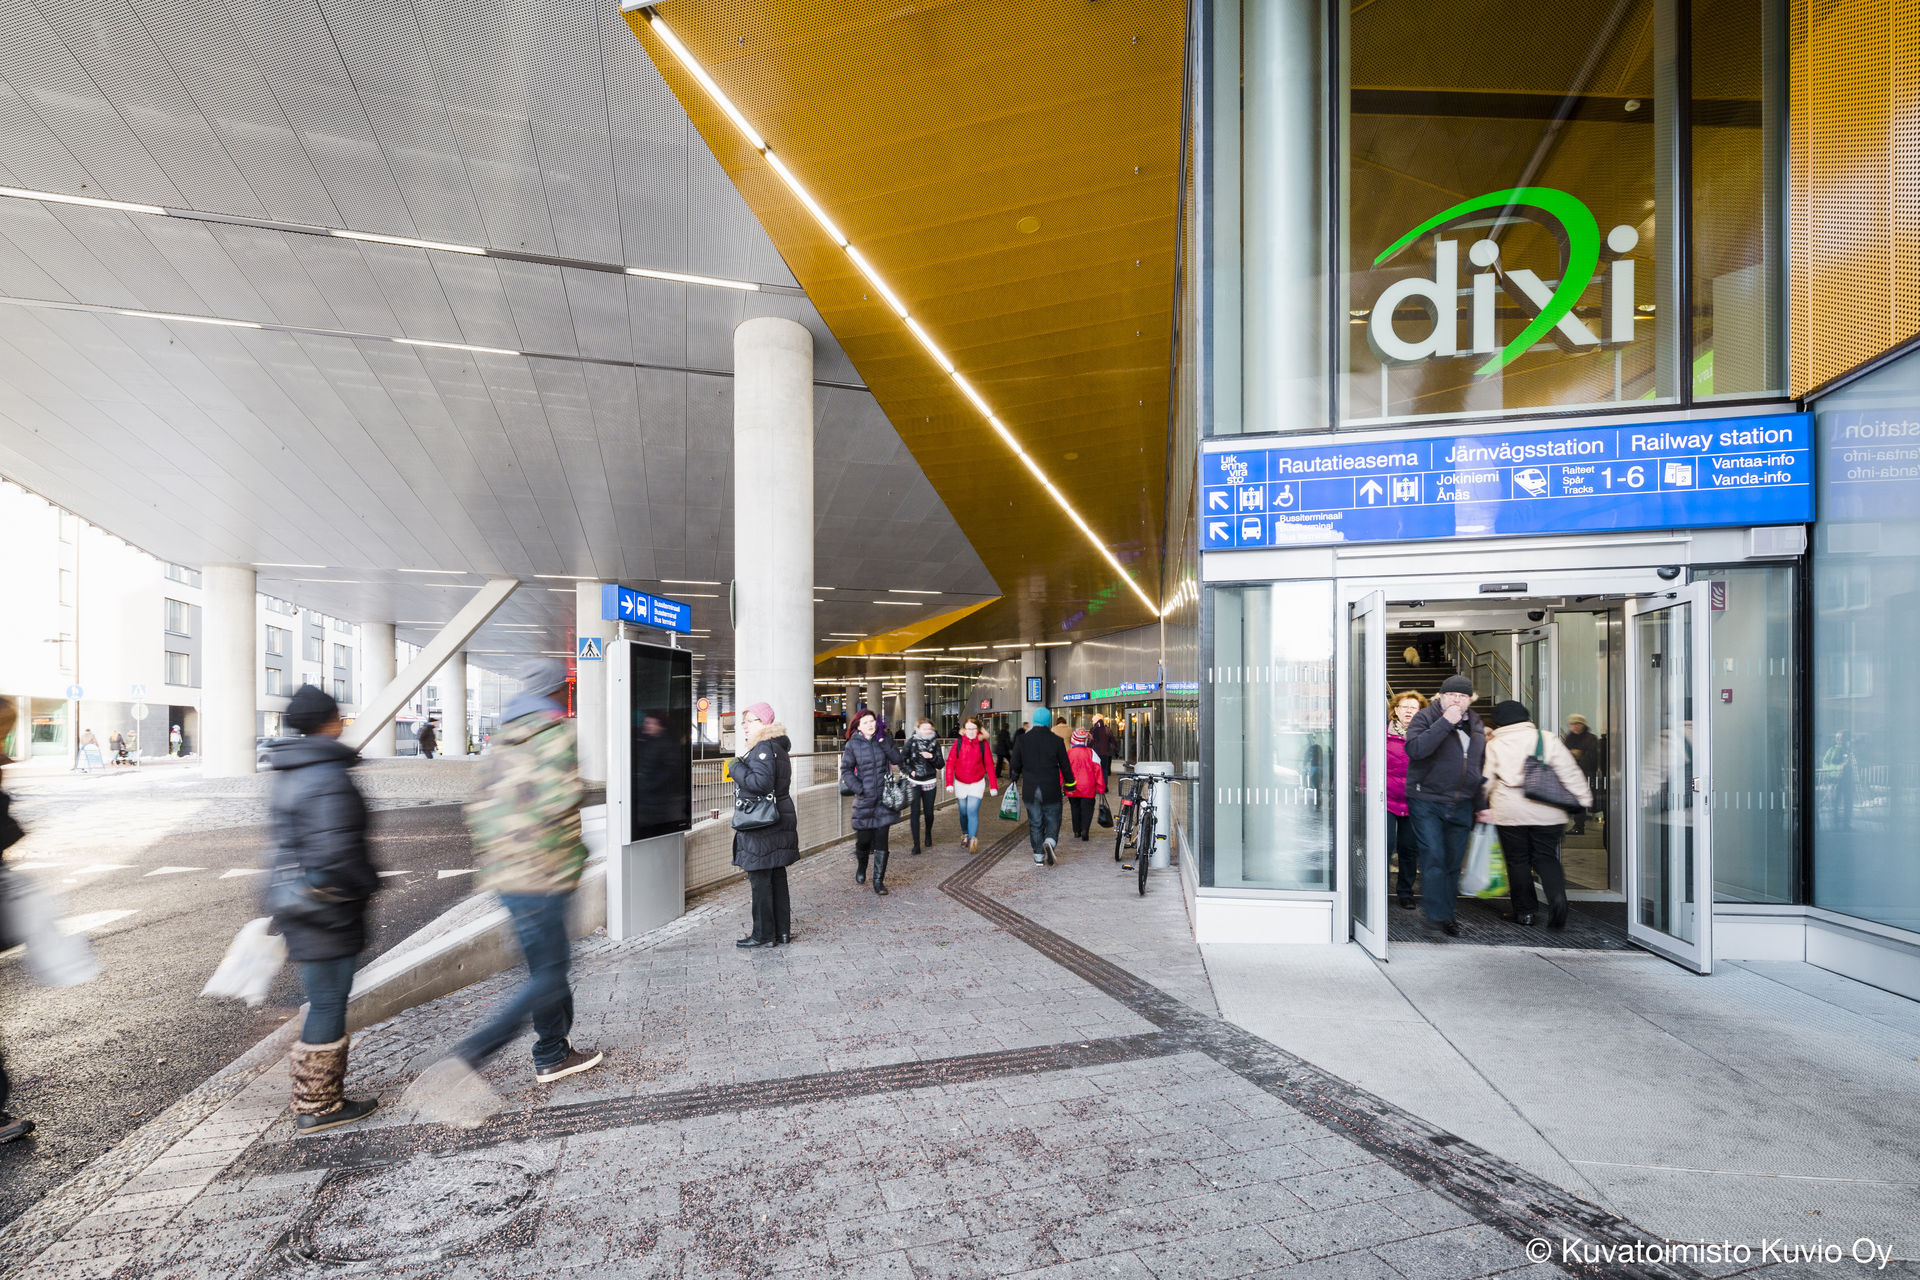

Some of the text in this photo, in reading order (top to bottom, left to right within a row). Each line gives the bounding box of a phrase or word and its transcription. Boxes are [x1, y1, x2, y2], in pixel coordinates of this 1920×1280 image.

[1371, 187, 1638, 375] dixi
[1631, 426, 1793, 452] Railway station
[1445, 438, 1604, 463] Järnvägsstation
[1279, 452, 1419, 475] Rautatieasema
[1562, 465, 1596, 475] Raiteet
[1712, 453, 1795, 470] Vantaa-info
[1436, 470, 1500, 486] Jokiniemi
[1562, 476, 1585, 486] Spår
[1601, 465, 1645, 489] 1-6
[1712, 470, 1792, 487] Vanda-info
[1436, 486, 1471, 502] Ånäs
[1562, 485, 1594, 495] Tracks
